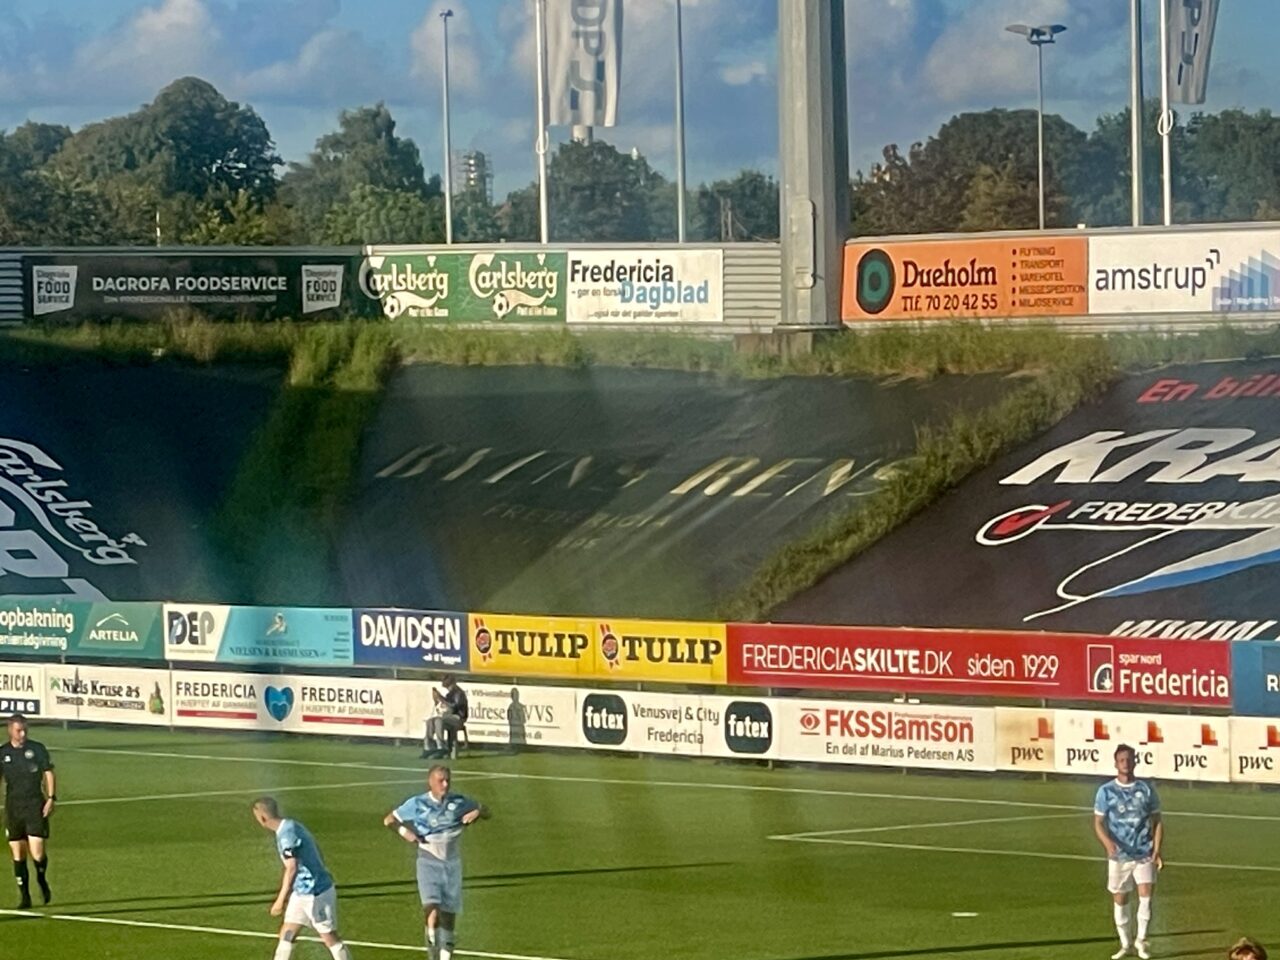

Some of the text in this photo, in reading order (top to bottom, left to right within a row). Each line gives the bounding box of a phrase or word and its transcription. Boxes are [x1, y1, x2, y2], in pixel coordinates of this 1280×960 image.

[569, 259, 674, 283] Fredericia
[902, 257, 998, 288] Dueholm
[1020, 259, 1065, 269] TRANSPORT
[92, 276, 287, 291] DAGROFA FOODSERVICE
[306, 280, 337, 292] FOOD
[359, 255, 449, 300] Carlsberg
[469, 253, 558, 298] Carlsberg
[1095, 262, 1207, 297] amstrup
[37, 281, 70, 294] FOOD
[306, 293, 337, 302] SERVICE
[619, 279, 709, 310] Dagblad
[926, 294, 942, 311] 70
[943, 294, 960, 311] 20
[961, 293, 980, 311] 42
[981, 292, 998, 310] 55
[1135, 378, 1198, 403] En
[0, 606, 75, 634] opbakning
[167, 610, 216, 646] DEP
[89, 629, 139, 642] ARTELIA
[360, 613, 461, 652] DAVIDSEN
[495, 629, 589, 659] TULIP
[621, 635, 722, 665] TULIP
[743, 643, 1060, 679] FREDERICIASKILTE.DK siden 1929
[90, 680, 124, 697] Kruse
[176, 681, 257, 700] FREDERICIA
[1119, 667, 1230, 698] Fredericia
[301, 686, 384, 705] FREDERICIA
[632, 703, 721, 726] Venusvej & City
[647, 726, 704, 745] Fredericia
[826, 742, 975, 763] En del af Marius Pedersen A/S
[1011, 746, 1044, 765] pwc
[1066, 748, 1099, 766] pwc
[1174, 753, 1208, 772] pwc
[1238, 755, 1274, 774] pwc
